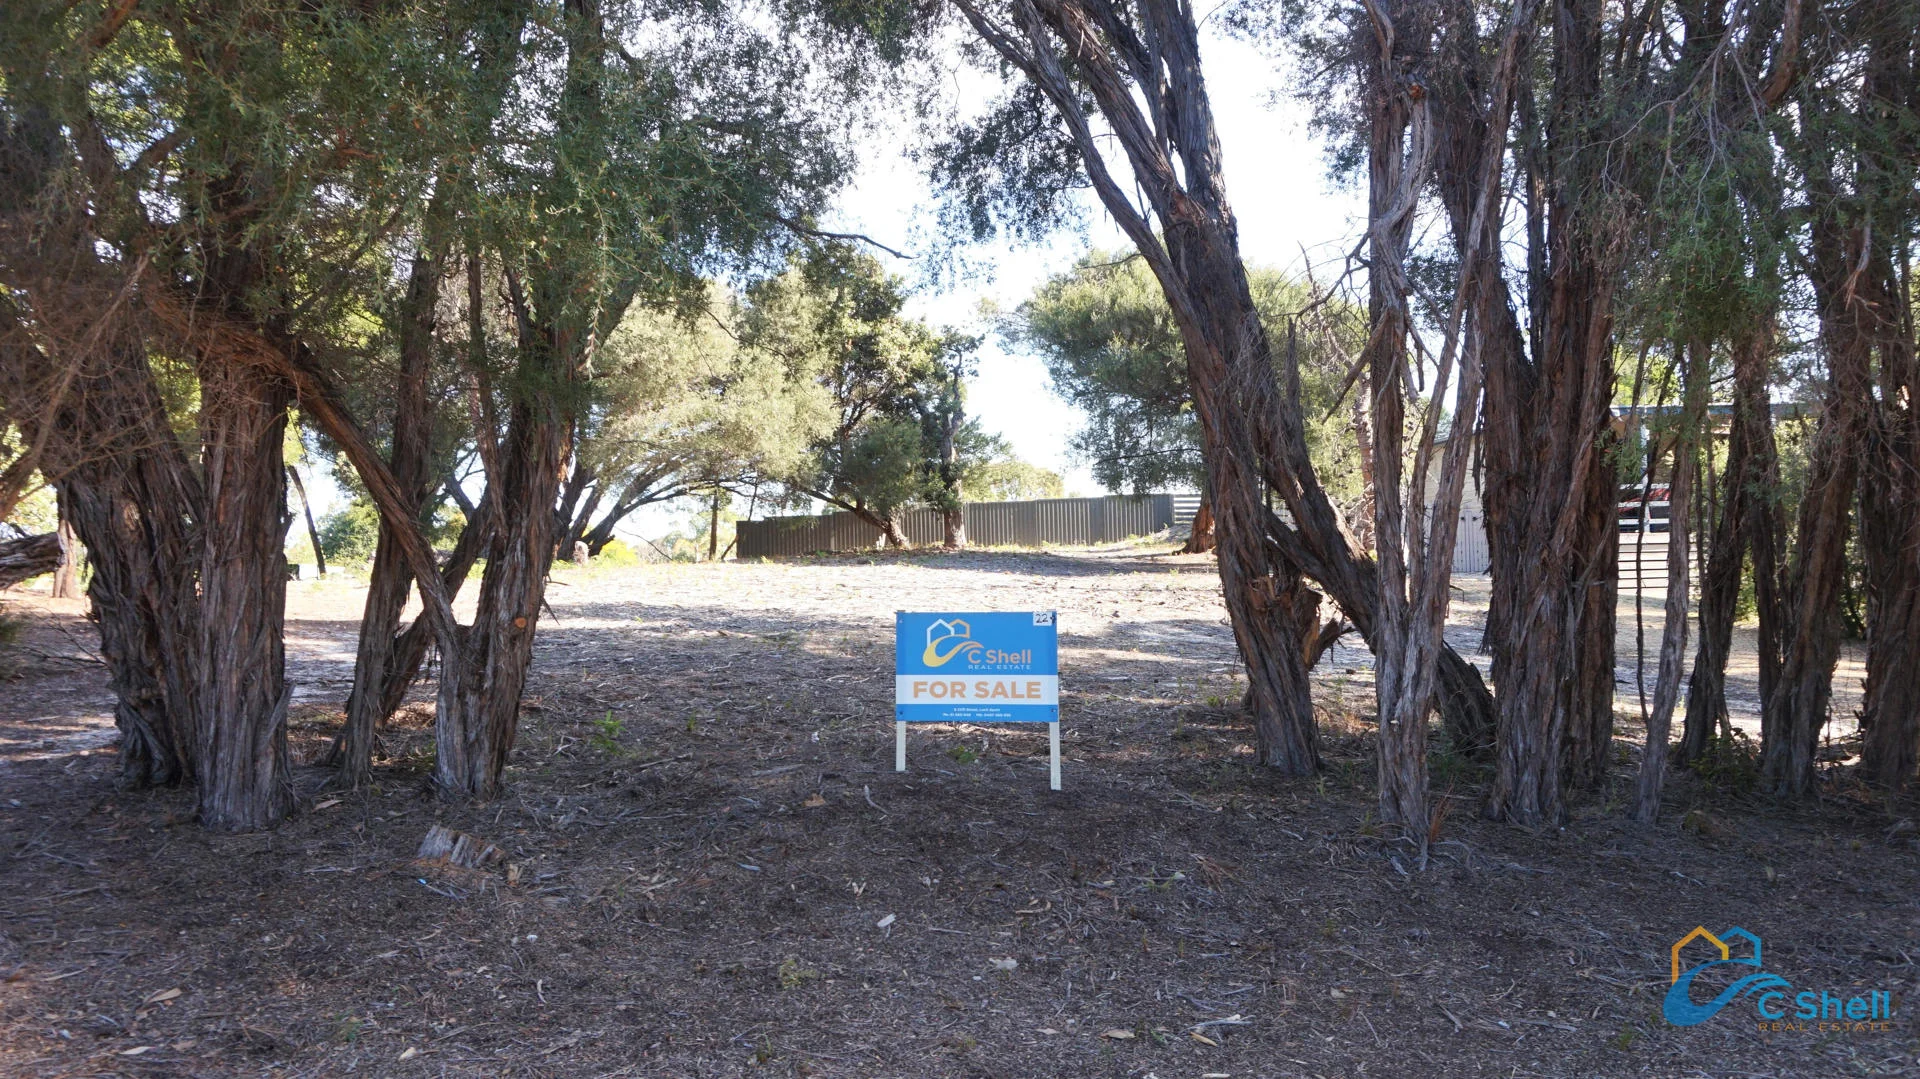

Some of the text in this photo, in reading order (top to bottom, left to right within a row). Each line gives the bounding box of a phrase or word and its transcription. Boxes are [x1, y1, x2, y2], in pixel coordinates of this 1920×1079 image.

[1035, 612, 1049, 624] 22
[968, 648, 1032, 664] C Shell
[913, 681, 1042, 699] FOR SALE
